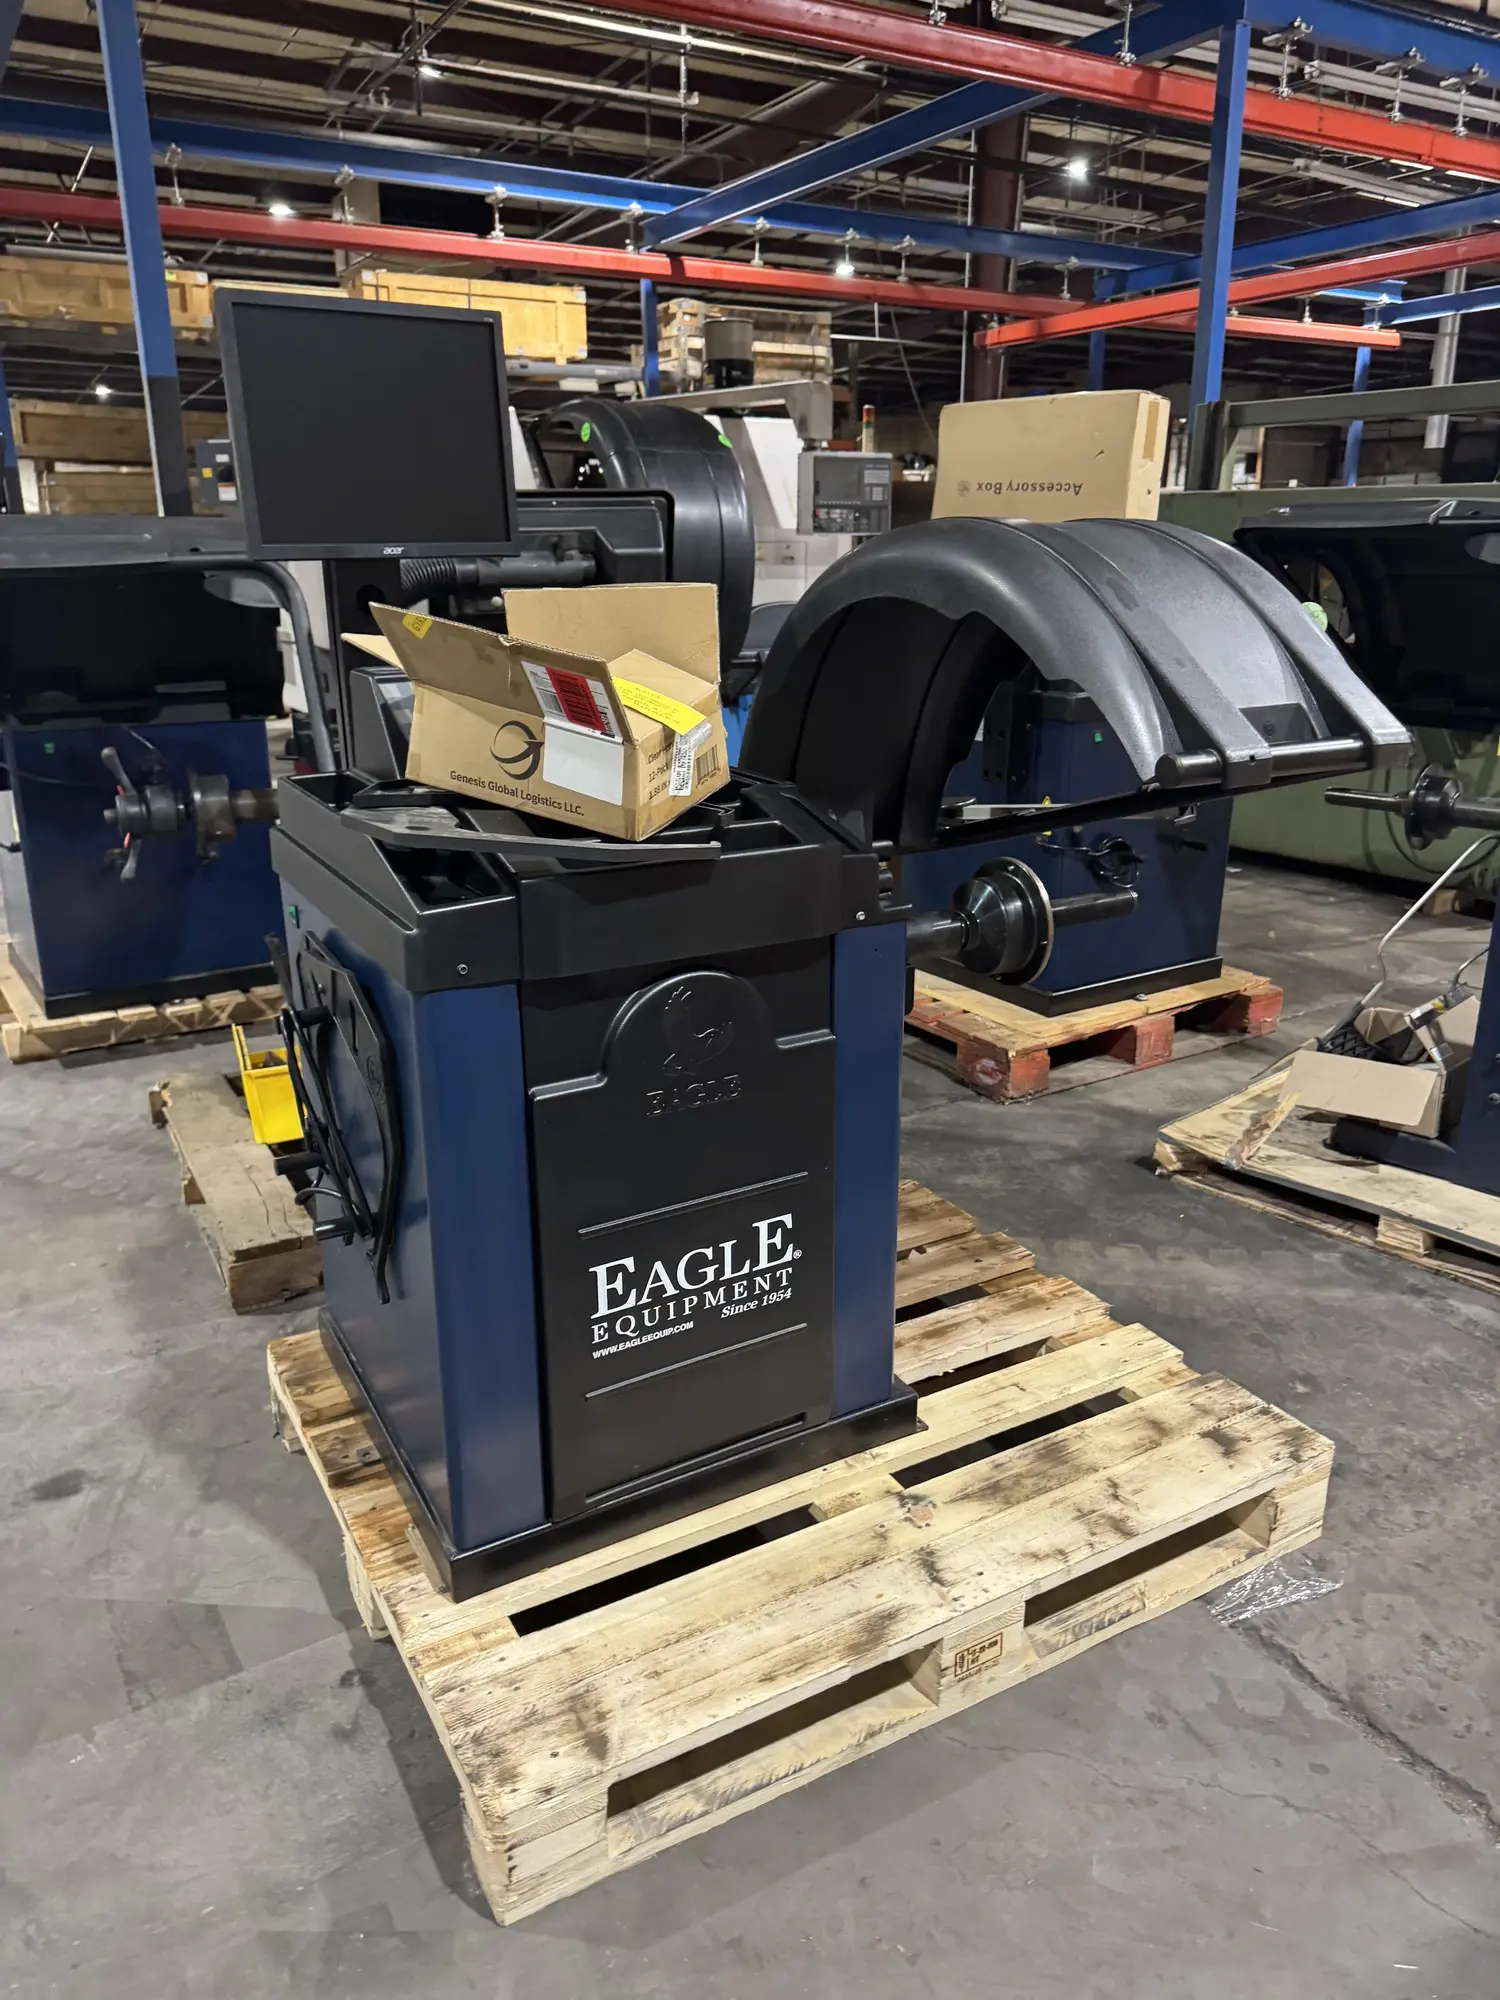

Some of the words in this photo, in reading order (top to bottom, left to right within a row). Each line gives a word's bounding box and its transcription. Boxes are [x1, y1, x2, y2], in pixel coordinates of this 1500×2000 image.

[976, 482, 1003, 495] Box
[1006, 479, 1083, 496] Accessory
[383, 546, 405, 555] acer
[450, 770, 487, 789] Genesis
[488, 780, 519, 798] Global
[520, 789, 563, 810] Logistics
[564, 803, 585, 817] LLC.
[645, 1074, 742, 1118] EAGLE
[591, 1267, 793, 1344] EQUIPMENT
[720, 1298, 758, 1319] Since
[761, 1287, 793, 1307] 1954
[592, 1320, 694, 1359] WWW.EAGLEEQUIP.COM
